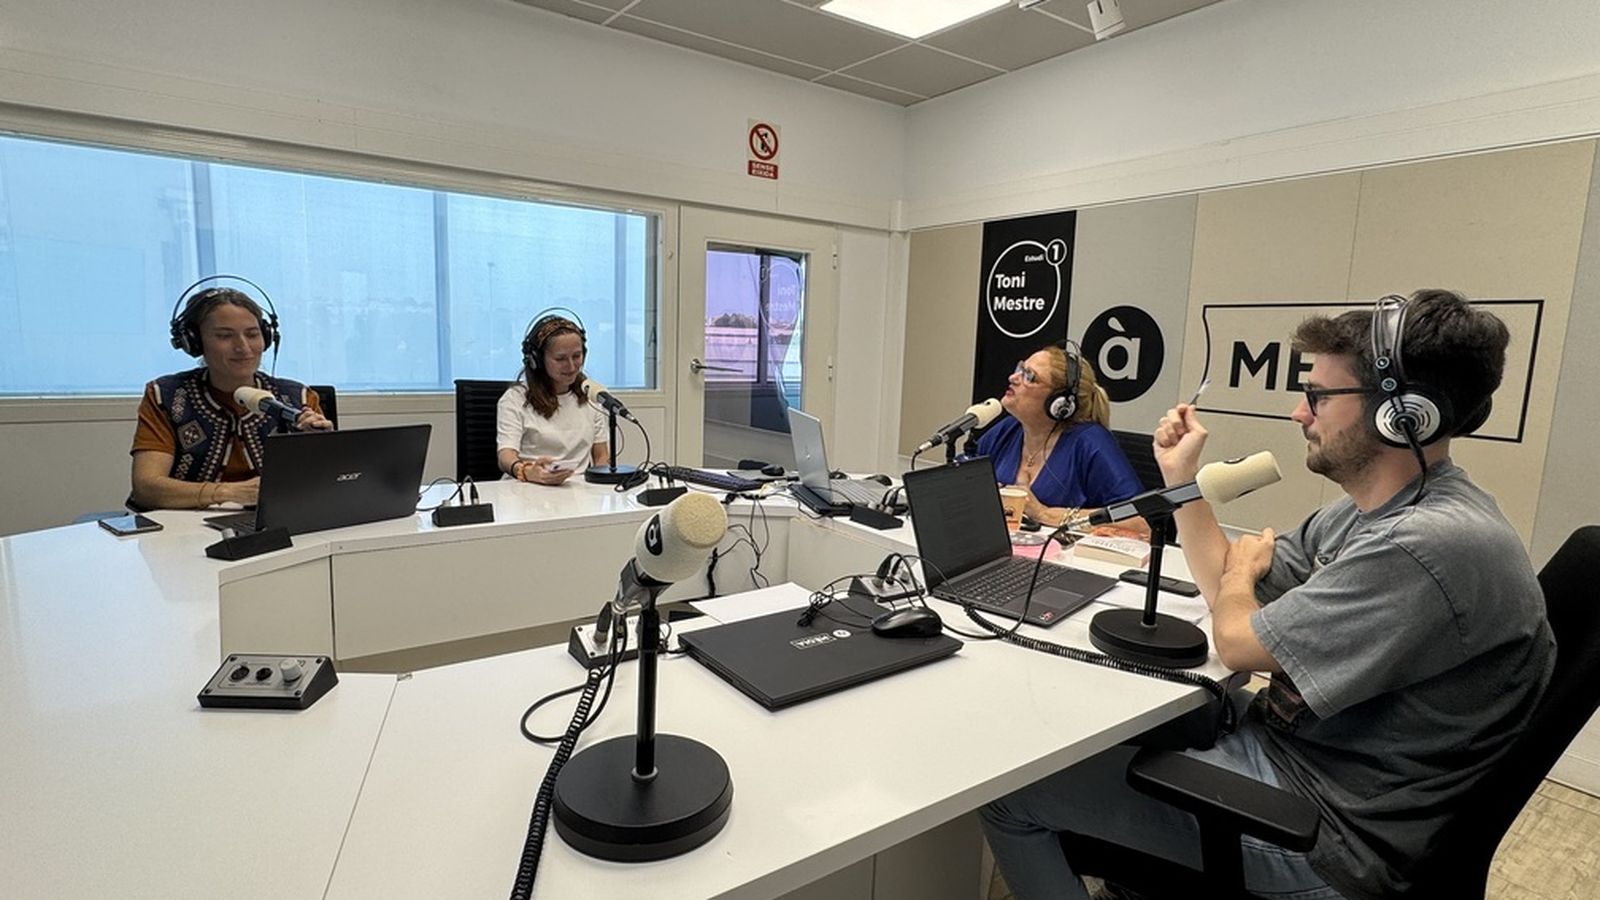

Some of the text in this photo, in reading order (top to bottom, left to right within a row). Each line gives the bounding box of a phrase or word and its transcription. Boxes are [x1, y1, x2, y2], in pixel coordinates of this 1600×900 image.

[1052, 244, 1060, 261] 1
[995, 271, 1026, 289] Toni
[993, 296, 1045, 311] Mestre
[336, 472, 362, 481] acer
